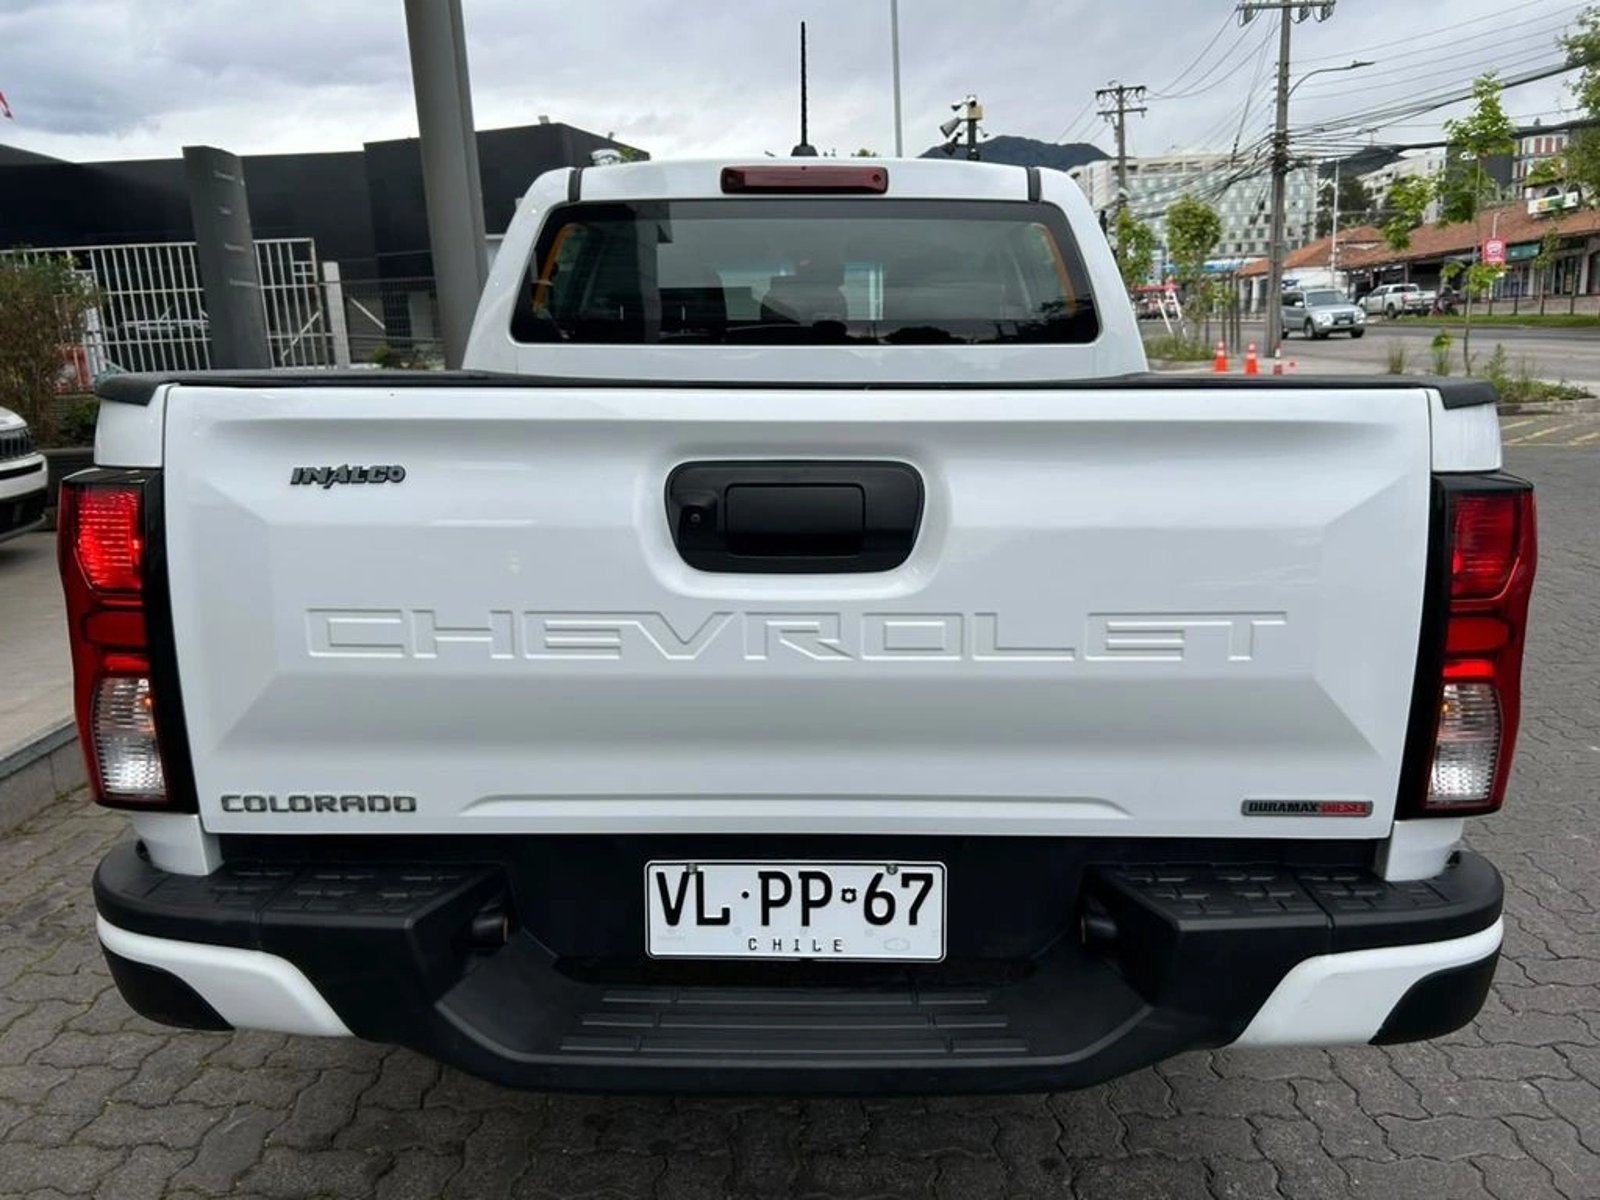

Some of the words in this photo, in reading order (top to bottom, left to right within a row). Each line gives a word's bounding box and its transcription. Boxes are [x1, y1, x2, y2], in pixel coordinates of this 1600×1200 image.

[305, 608, 1288, 661] CHEVROLET
[220, 795, 417, 812] COLORADO
[1248, 801, 1320, 813] DURAMAX
[747, 938, 844, 952] CHILE
